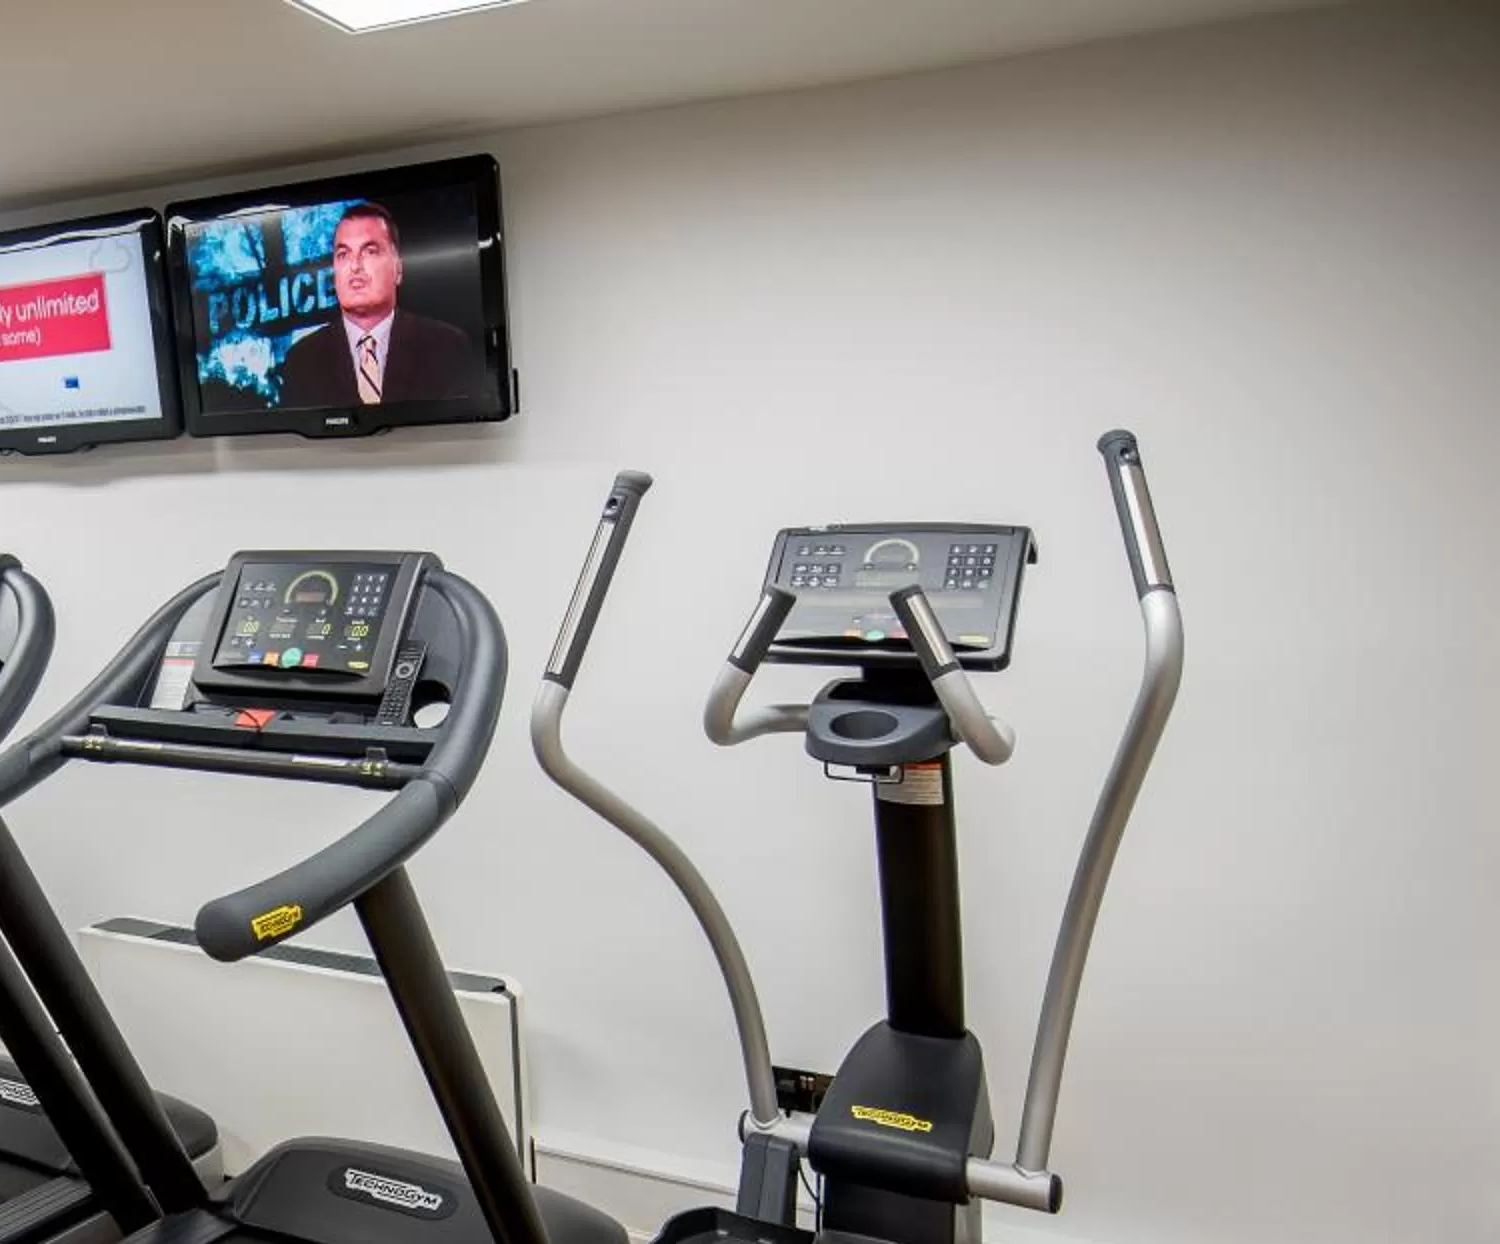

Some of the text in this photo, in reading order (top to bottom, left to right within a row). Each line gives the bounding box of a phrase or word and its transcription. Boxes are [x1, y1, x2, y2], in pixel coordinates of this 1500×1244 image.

[15, 288, 100, 321] unlimited
[208, 267, 337, 334] POLICE
[2, 327, 41, 347] some)
[346, 1169, 442, 1209] TECHNOGYM
